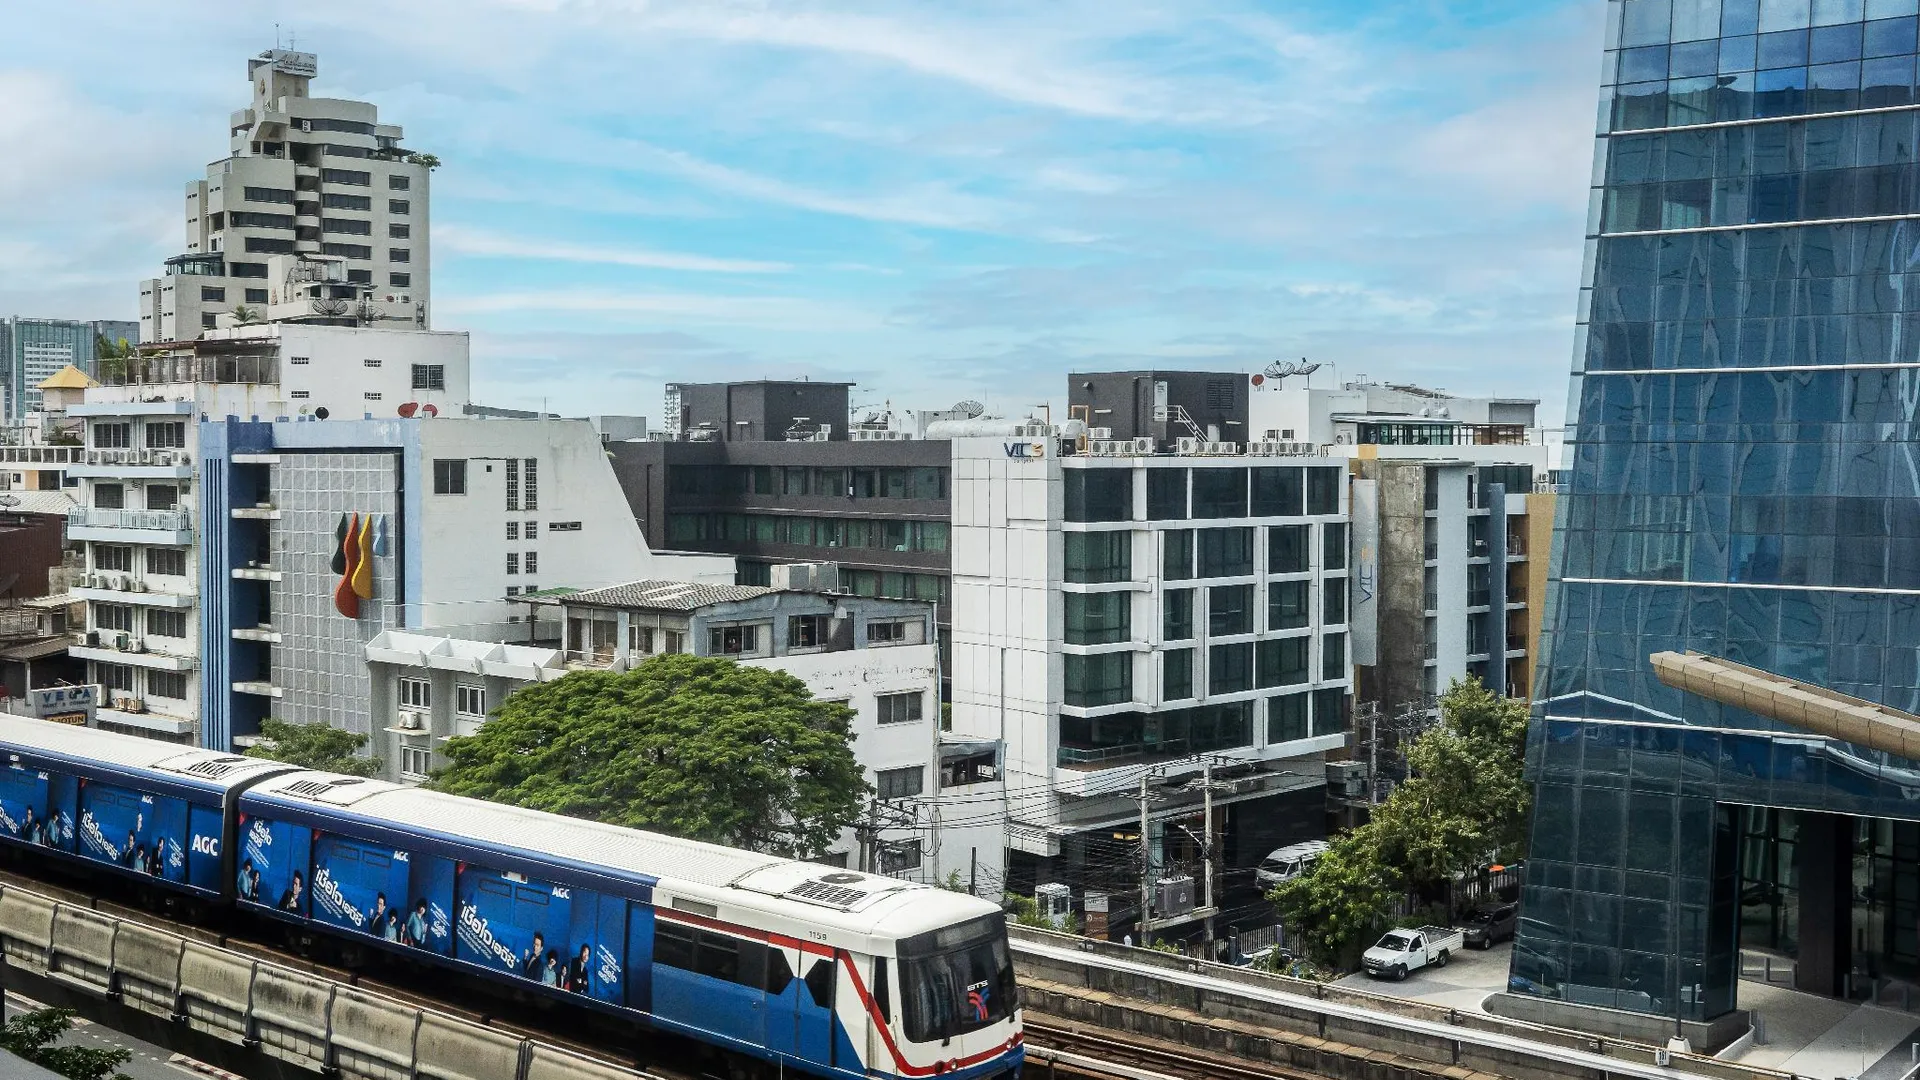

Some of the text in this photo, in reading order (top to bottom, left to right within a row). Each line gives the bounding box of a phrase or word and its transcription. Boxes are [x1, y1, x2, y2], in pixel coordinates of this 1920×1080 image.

[141, 795, 153, 804] AGC
[191, 833, 218, 857] AGC
[393, 850, 409, 862] AGC
[552, 886, 570, 899] AGC
[808, 930, 827, 941] 1159
[967, 979, 988, 991] BTS
